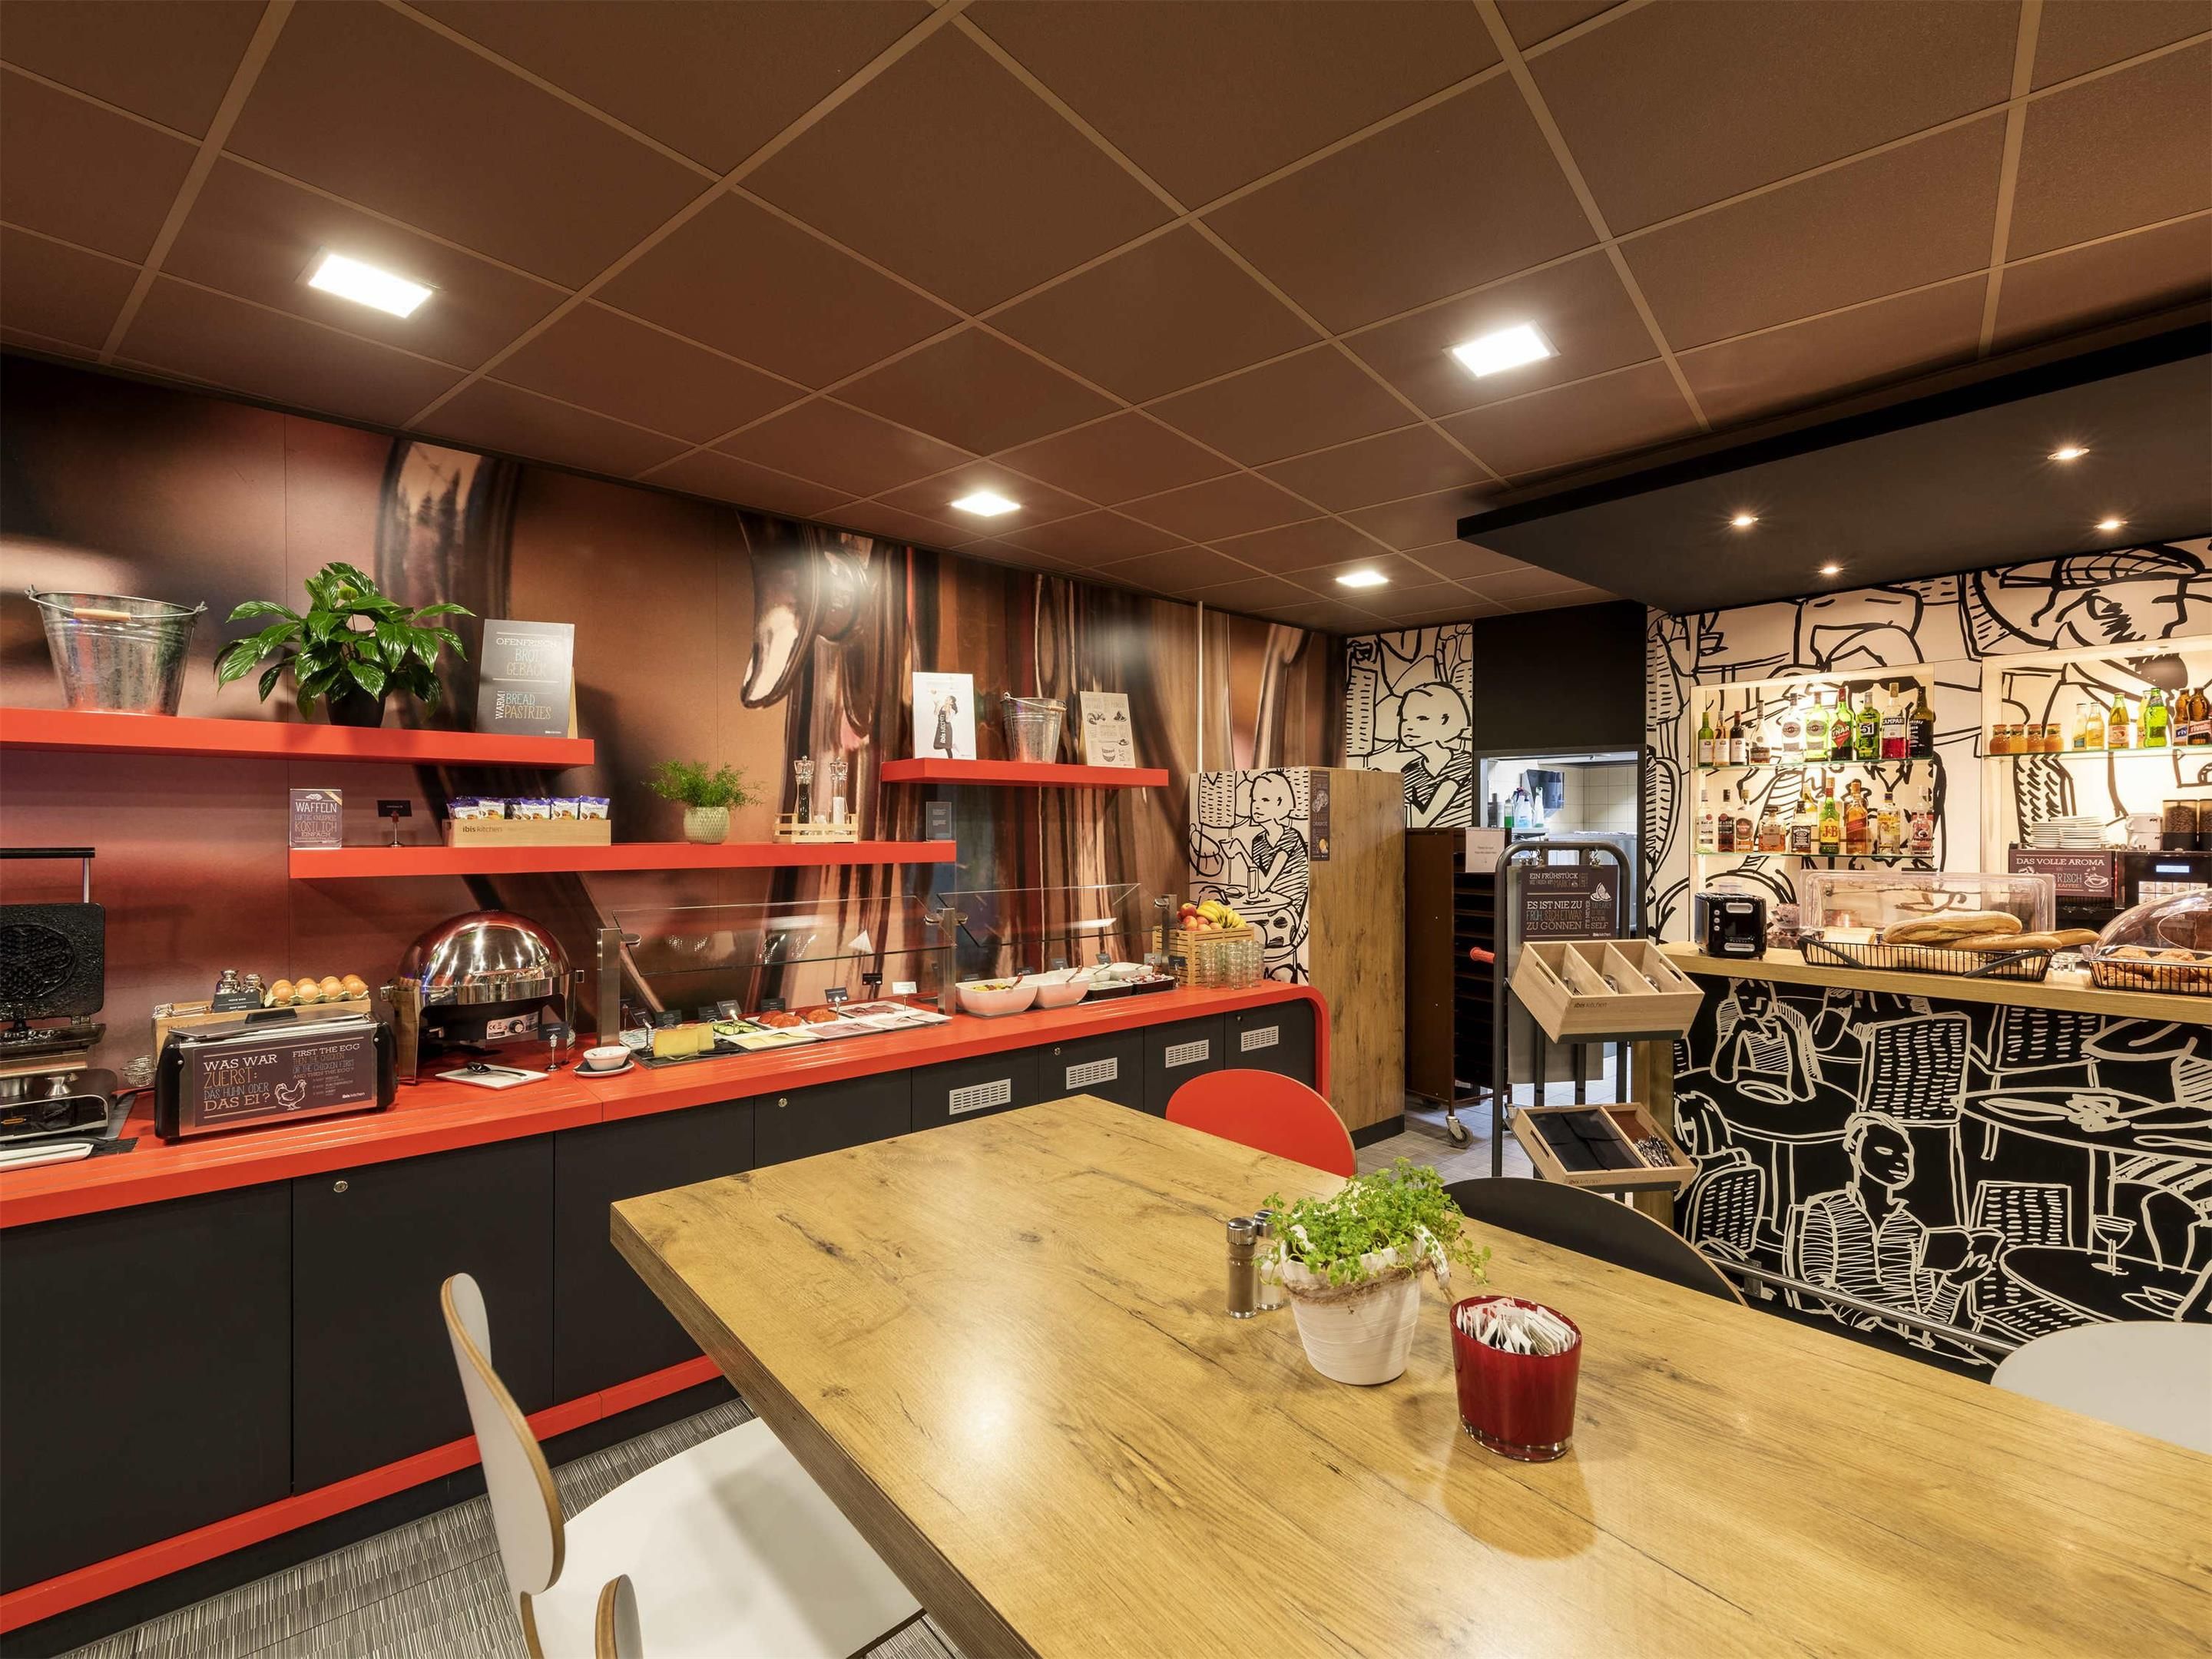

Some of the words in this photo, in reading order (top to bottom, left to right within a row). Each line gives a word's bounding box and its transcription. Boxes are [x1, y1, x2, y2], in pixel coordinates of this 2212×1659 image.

[504, 705, 551, 720] PASTRIES
[1860, 724, 1874, 734] 51
[295, 802, 337, 813] WAFFELN
[1527, 901, 1538, 909] ES
[1539, 901, 1553, 909] IST
[1571, 900, 1582, 909] ZU
[1526, 922, 1538, 930] ZU
[293, 1048, 317, 1058] FIRST
[320, 1046, 338, 1055] THE
[339, 1043, 360, 1051] EGG
[204, 1058, 239, 1071] WAS
[243, 1054, 277, 1066] WAR
[204, 1067, 257, 1089] ZUERST:
[204, 1088, 220, 1101] DAS
[223, 1084, 245, 1097] HUHN
[247, 1081, 270, 1094] ODER
[204, 1097, 240, 1111] DAS
